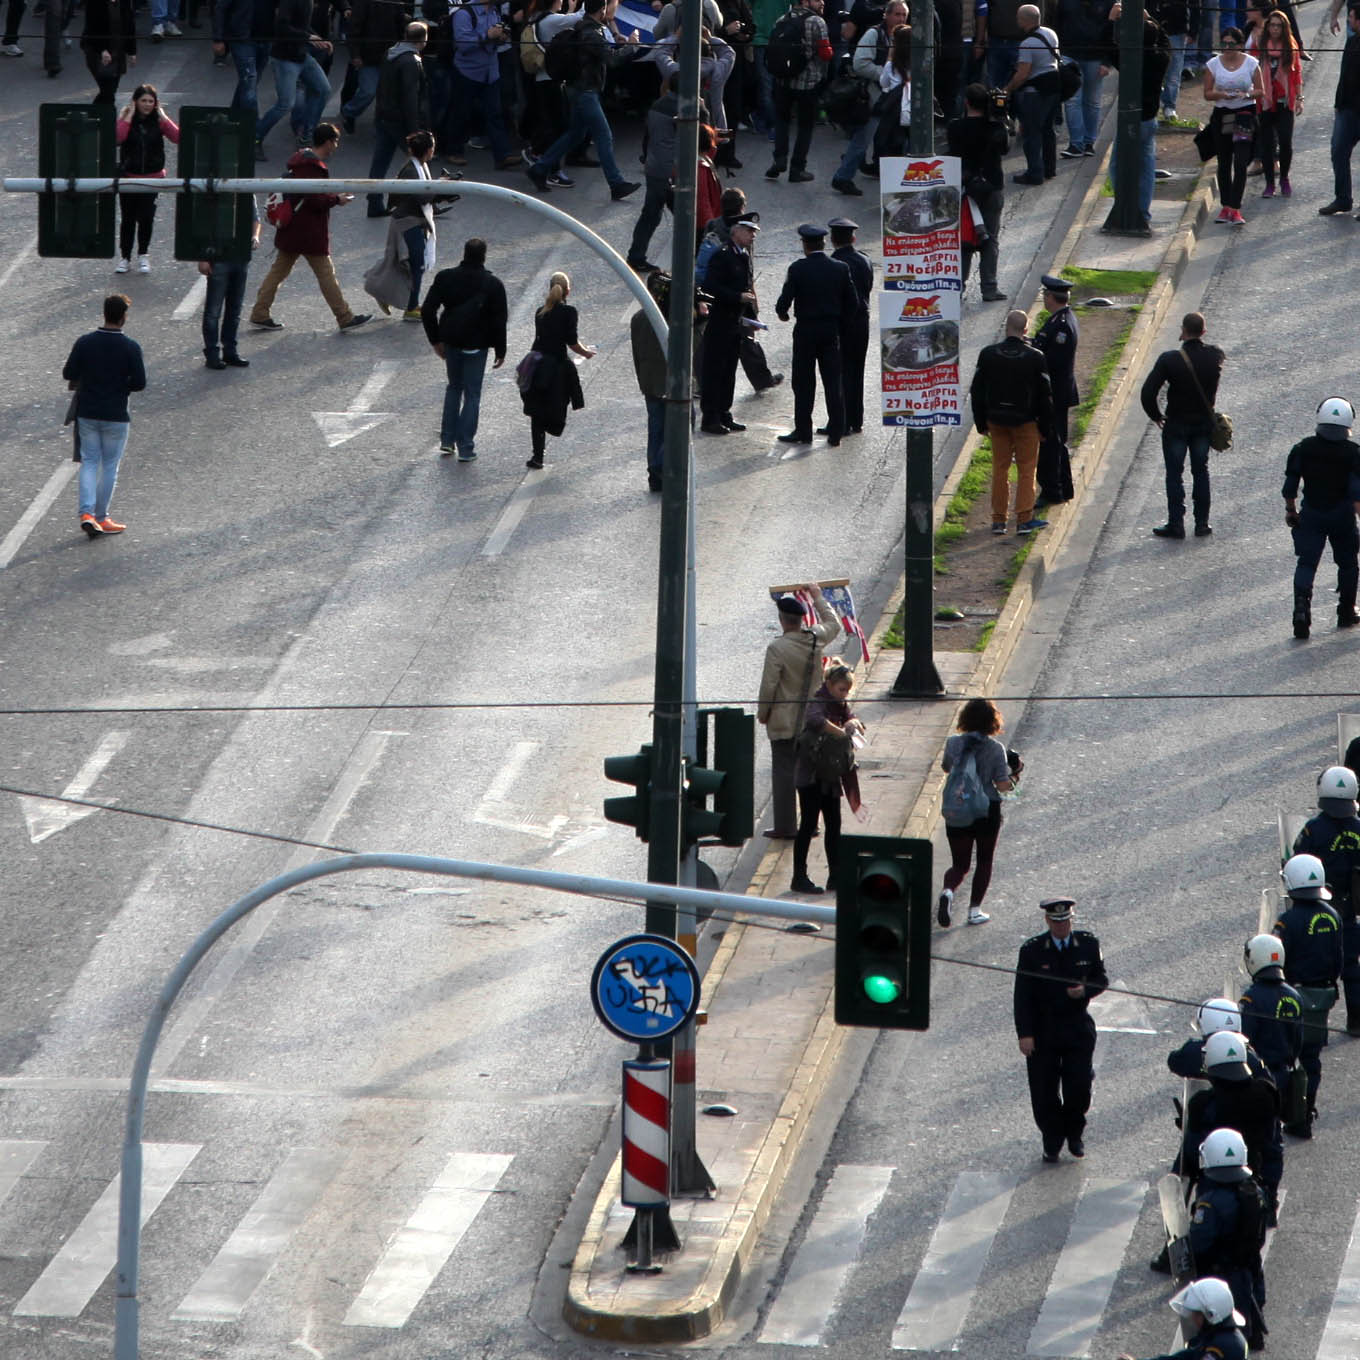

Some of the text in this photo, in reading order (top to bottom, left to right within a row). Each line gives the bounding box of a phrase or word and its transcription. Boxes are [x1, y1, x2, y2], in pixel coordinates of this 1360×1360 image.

[887, 263, 901, 273] 27
[886, 398, 901, 408] 27
[610, 955, 689, 981] FUCK
